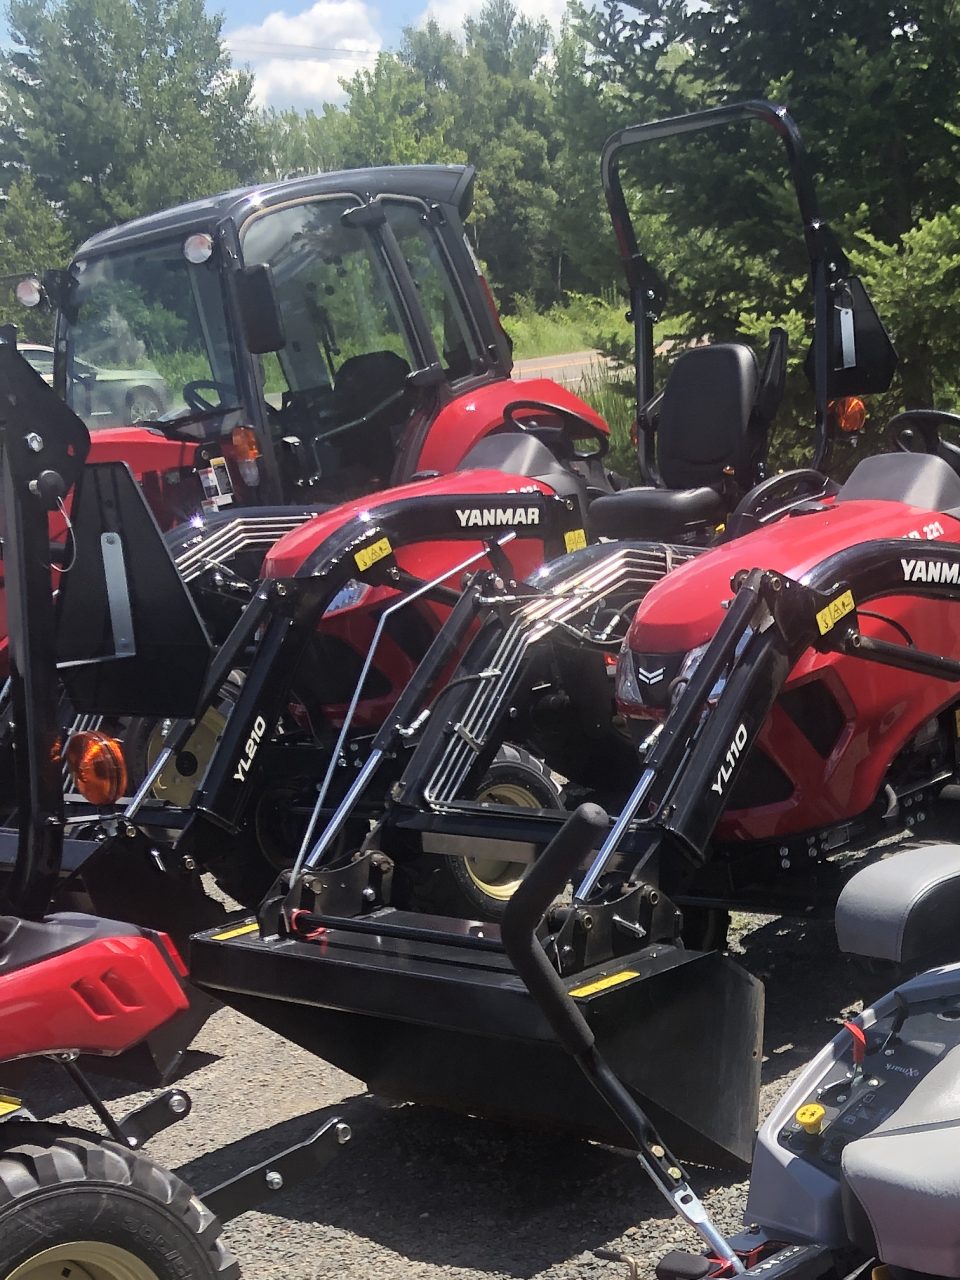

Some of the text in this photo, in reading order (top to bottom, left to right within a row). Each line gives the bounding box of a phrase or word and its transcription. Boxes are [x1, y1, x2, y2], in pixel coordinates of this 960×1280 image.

[455, 507, 540, 527] YANMAR
[233, 715, 266, 782] YL210
[711, 723, 748, 796] YL110
